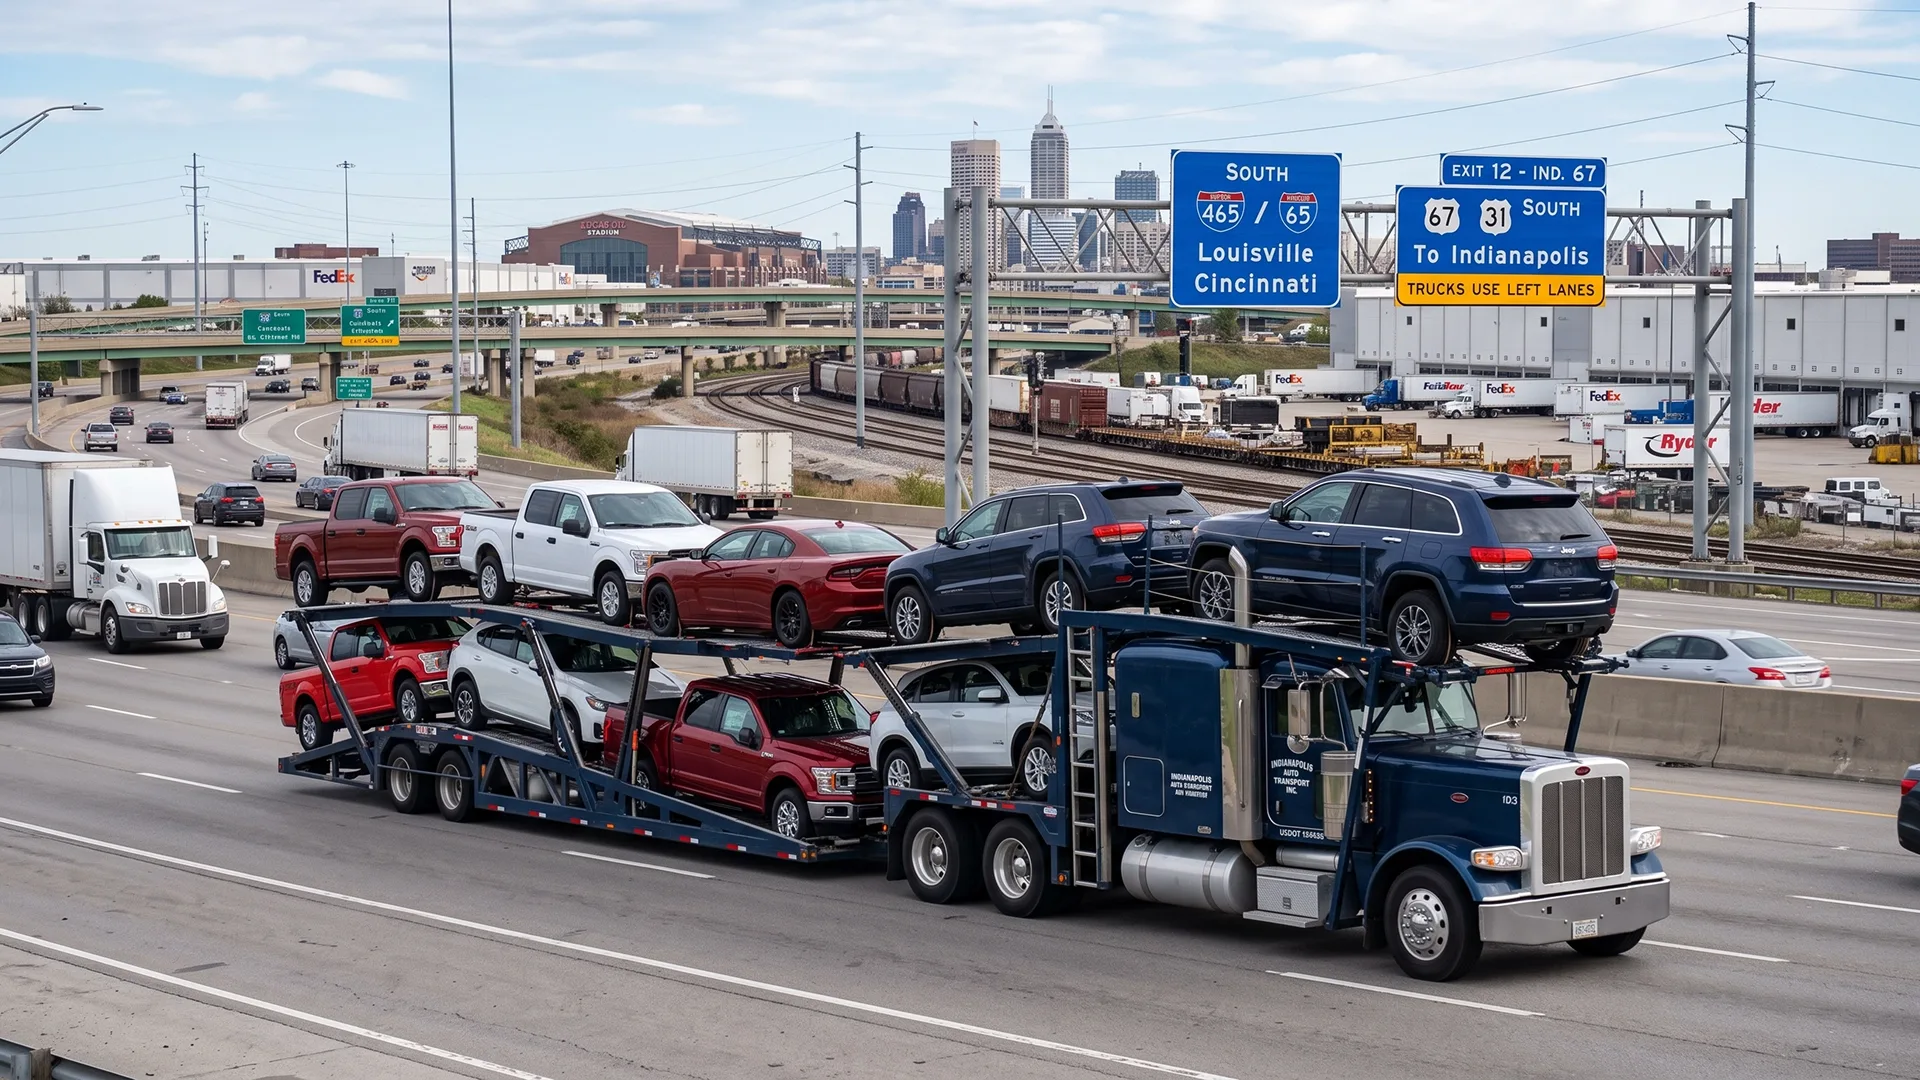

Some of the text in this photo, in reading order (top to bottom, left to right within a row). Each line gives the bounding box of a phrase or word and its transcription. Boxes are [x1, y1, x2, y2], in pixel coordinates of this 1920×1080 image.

[1226, 162, 1288, 182] SOUTH
[1452, 164, 1484, 177] EXIT
[1492, 163, 1512, 180] 12
[1533, 165, 1565, 180] IND.
[1573, 165, 1597, 181] 67
[1202, 203, 1239, 223] 465
[1286, 205, 1311, 225] 65
[1428, 198, 1581, 227] 67 31 SOUTH
[1198, 242, 1314, 263] Louisville
[1413, 244, 1589, 269] To Indianapolis
[313, 269, 355, 284] FedEx
[1194, 272, 1317, 293] Cincinnati
[1407, 282, 1595, 296] TRUCKS USE LEFT LANES
[1275, 373, 1303, 384] FedEx
[1486, 383, 1516, 394] FedEx
[1590, 390, 1621, 402] FedEx
[1753, 398, 1782, 414] der
[1660, 433, 1717, 452] Rydr
[1561, 546, 1576, 554] Jeep
[1270, 758, 1314, 772] INDIANAPOLIS
[1283, 769, 1299, 777] AUTO
[1273, 777, 1310, 787] TRANSPORT
[1285, 786, 1298, 795] INC.
[1279, 828, 1301, 838] USDOT
